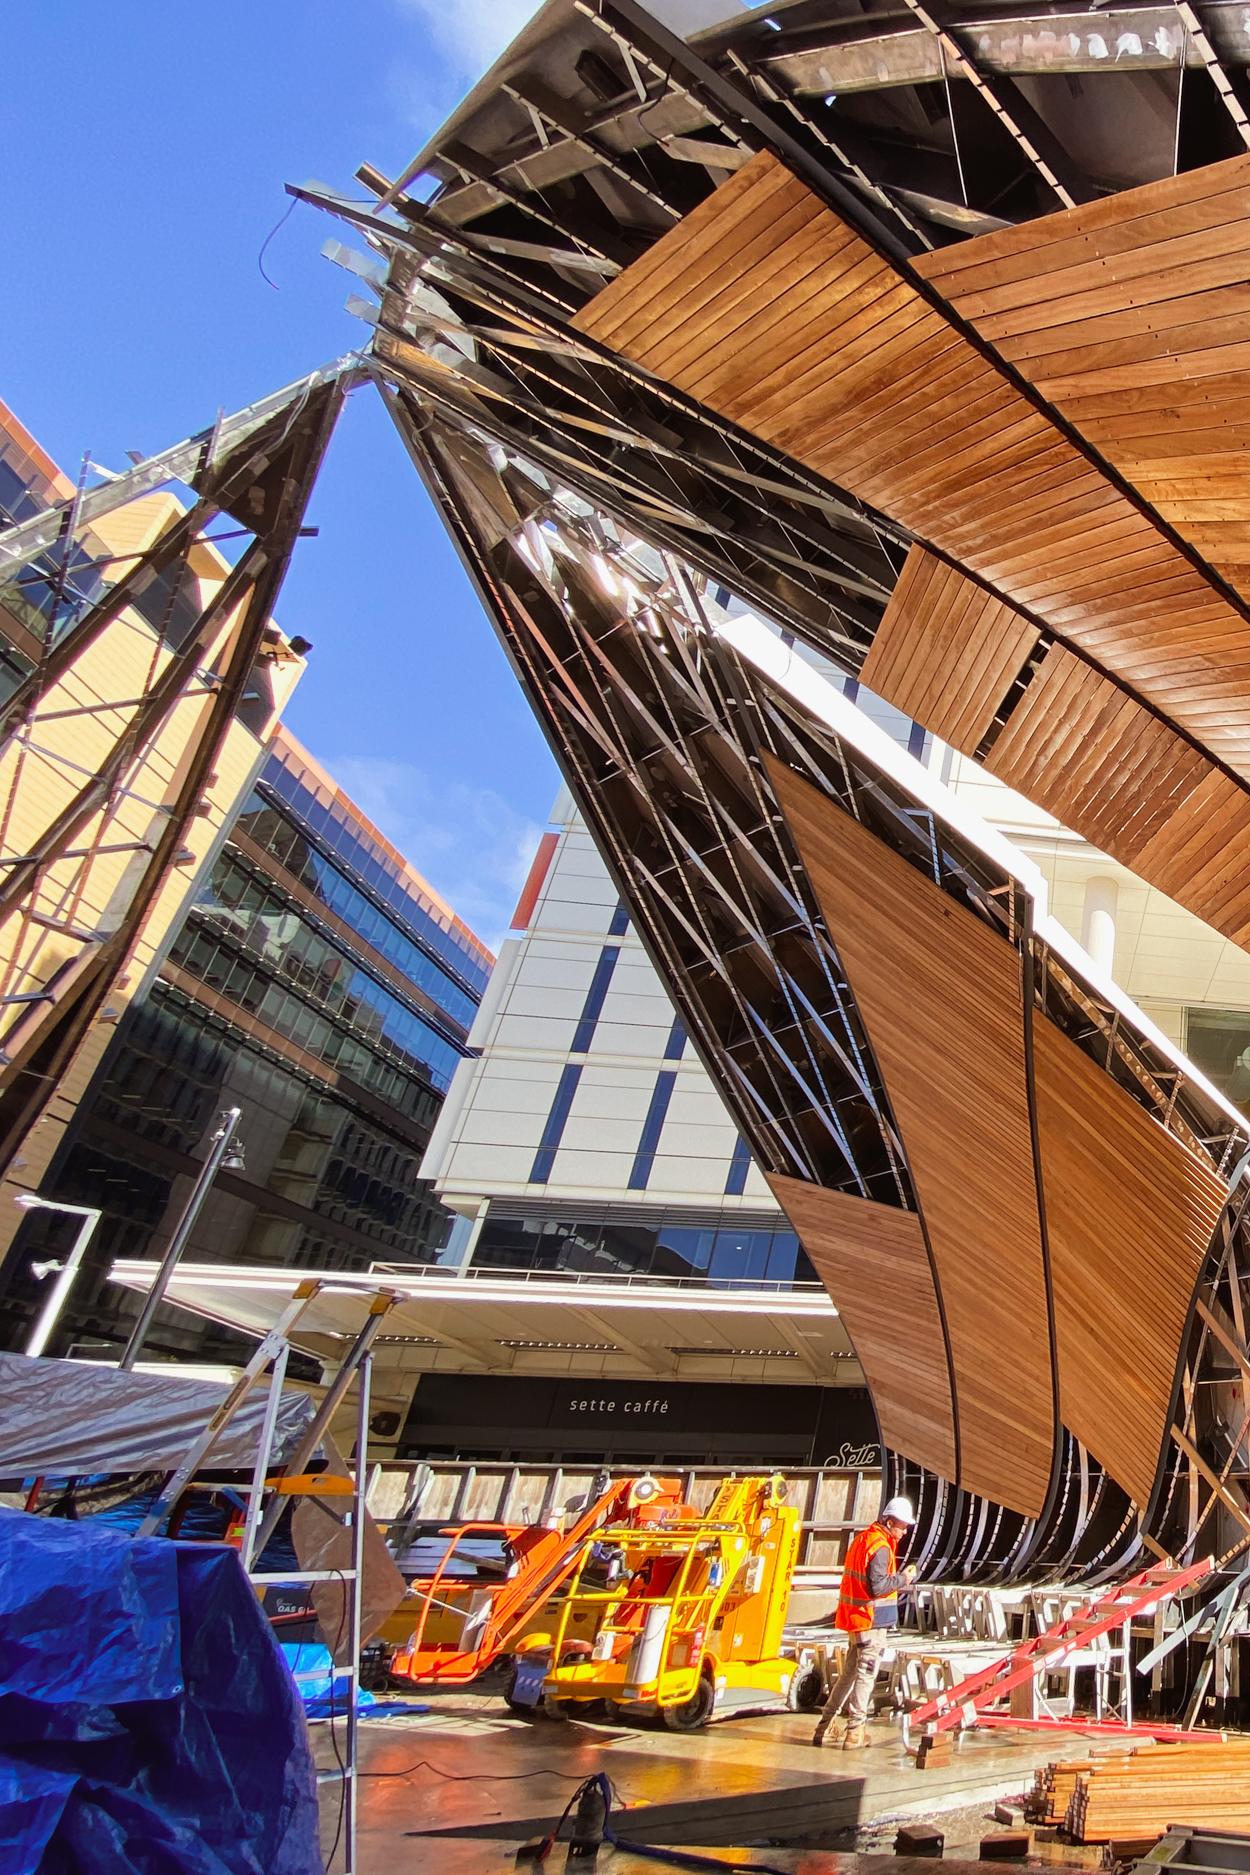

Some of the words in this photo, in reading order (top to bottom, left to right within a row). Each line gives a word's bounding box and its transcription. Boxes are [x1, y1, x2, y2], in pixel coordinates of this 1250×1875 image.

[569, 1400, 616, 1412] sette
[824, 1442, 881, 1467] Sette
[784, 1537, 796, 1582] STAR
